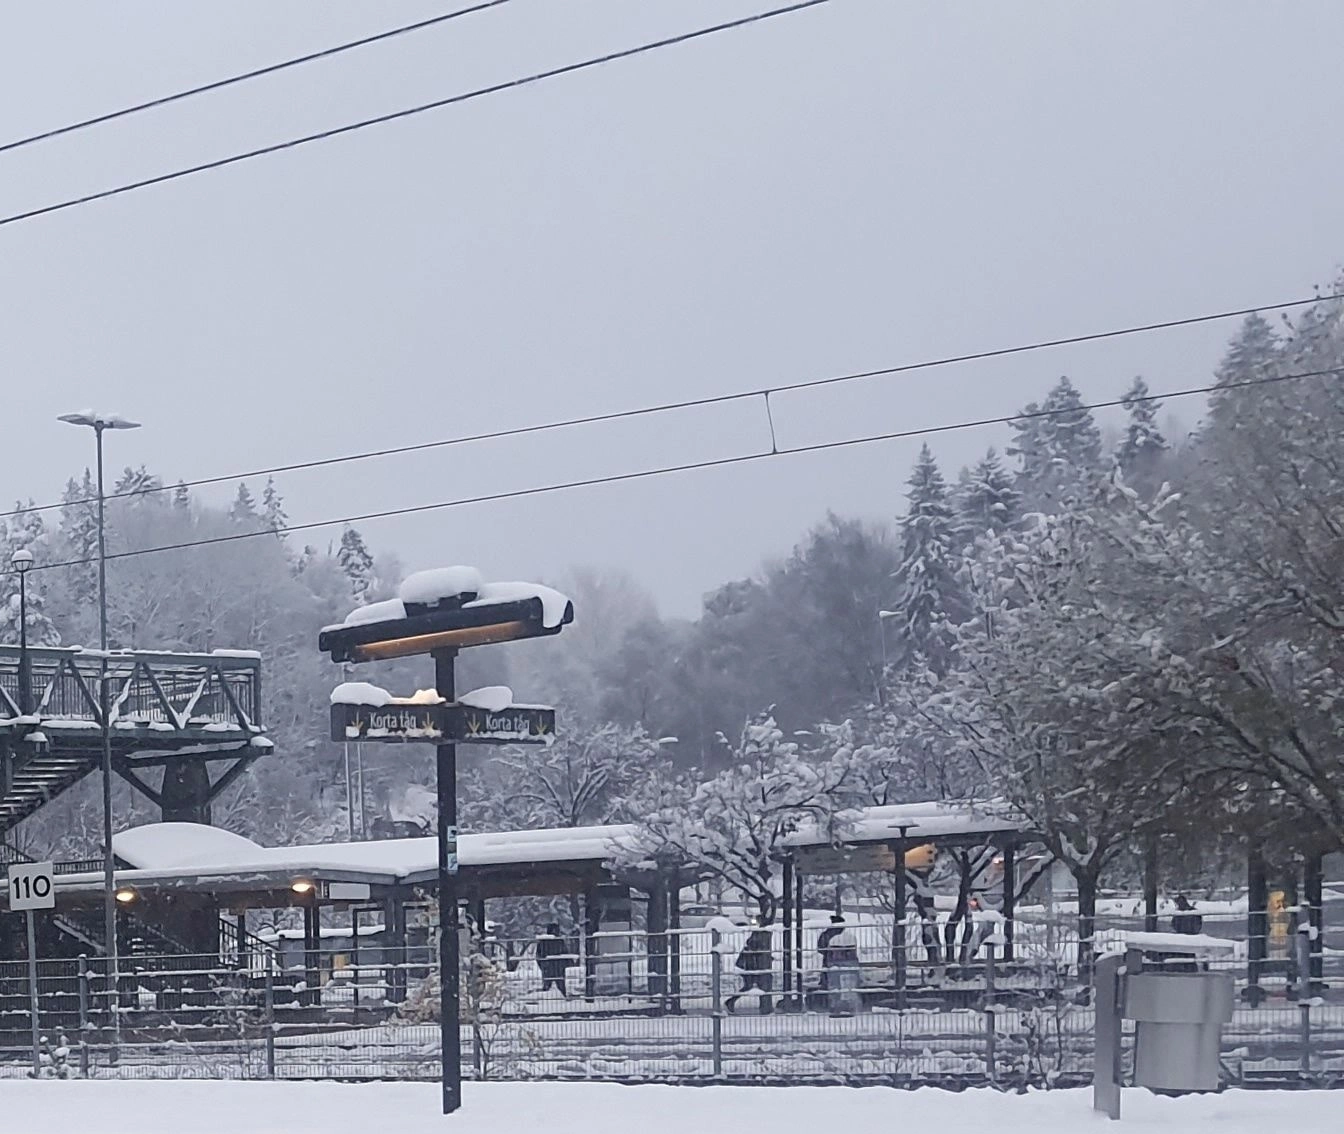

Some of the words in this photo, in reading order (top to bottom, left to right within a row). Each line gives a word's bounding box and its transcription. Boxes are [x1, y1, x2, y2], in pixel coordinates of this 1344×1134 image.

[369, 711, 398, 729] Korta
[485, 714, 512, 731] Korta
[12, 875, 51, 899] 110
